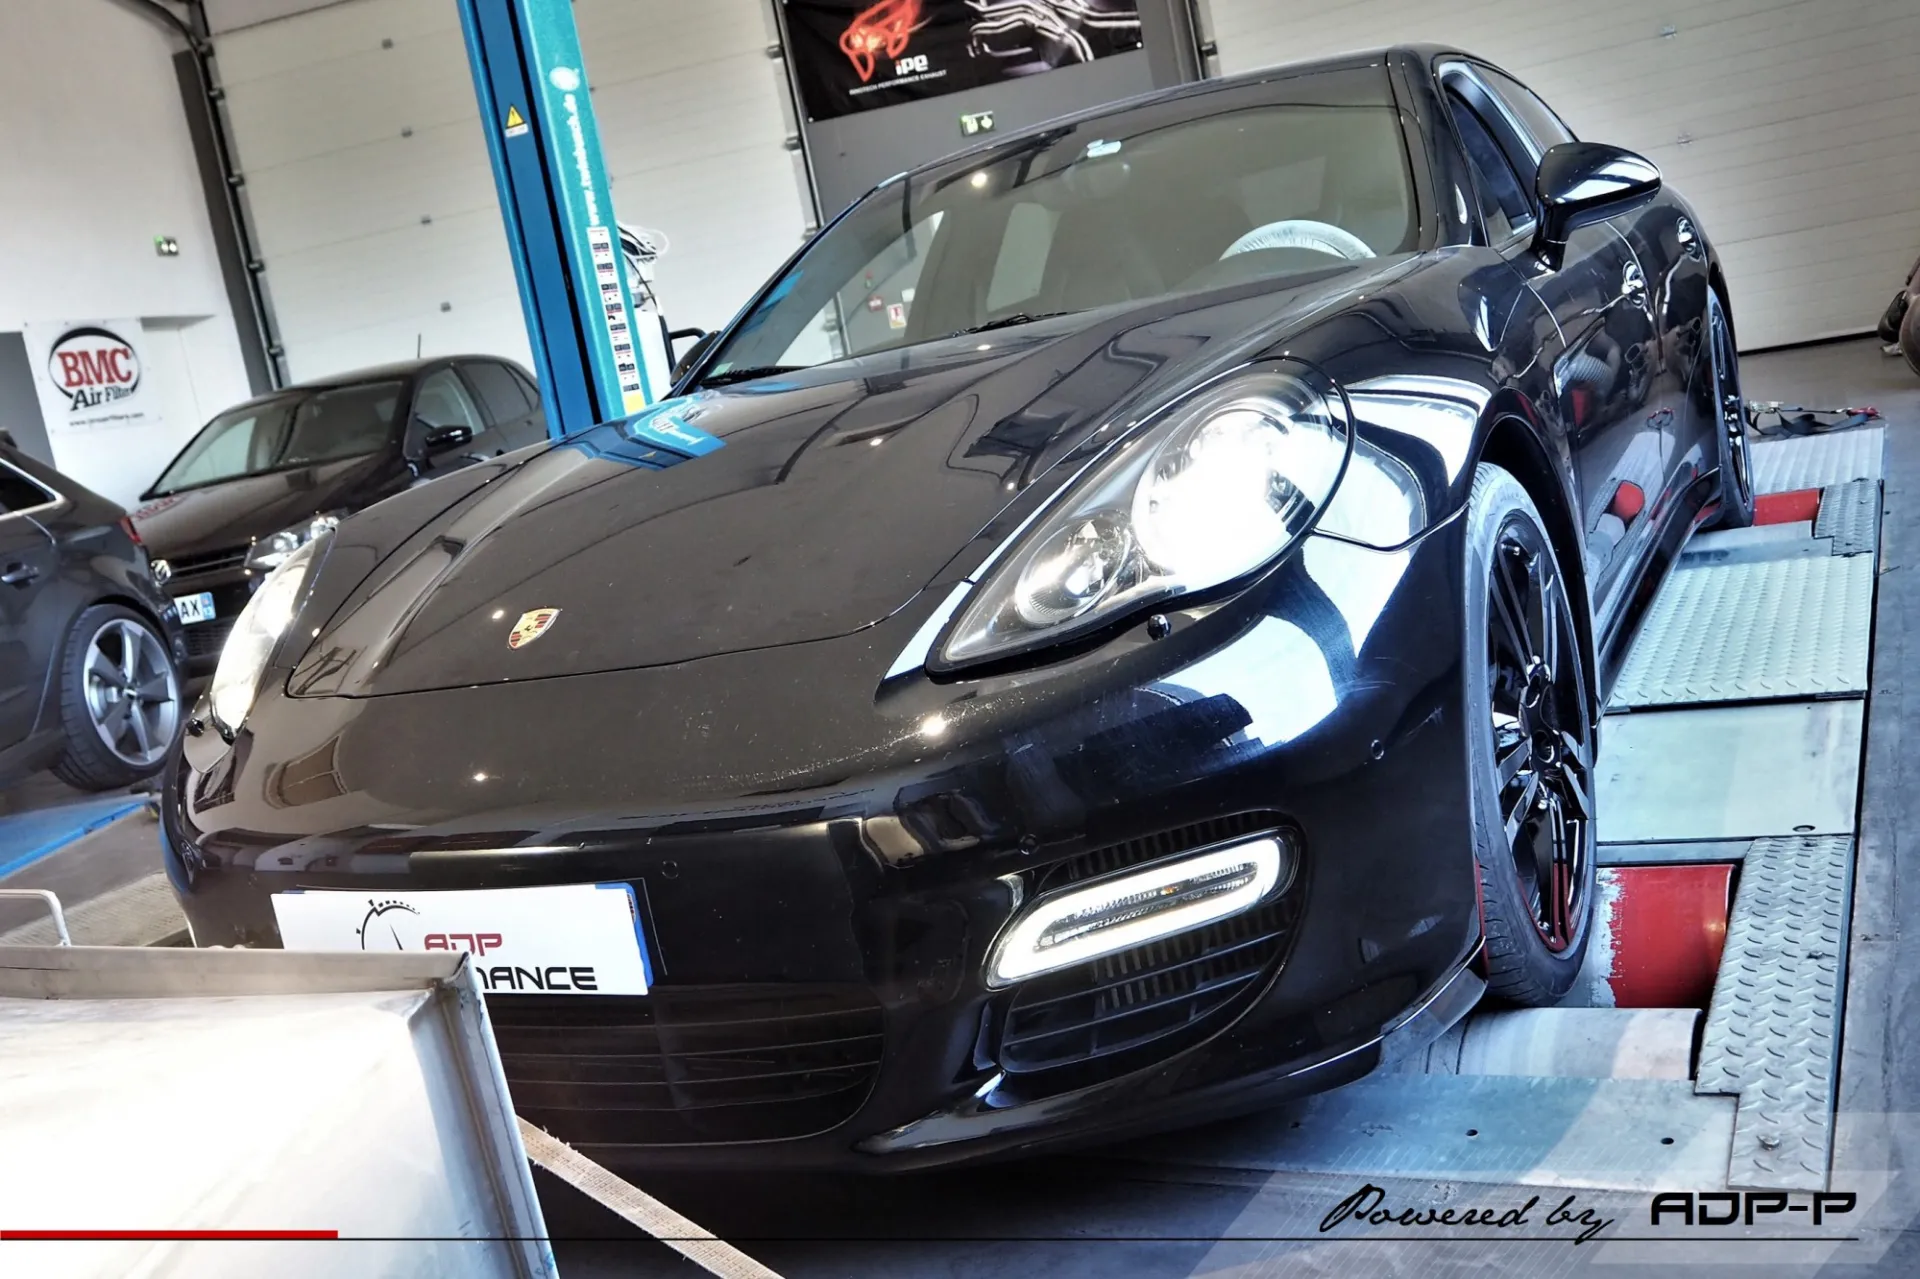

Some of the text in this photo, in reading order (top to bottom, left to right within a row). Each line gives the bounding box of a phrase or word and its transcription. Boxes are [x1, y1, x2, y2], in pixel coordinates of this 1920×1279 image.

[58, 348, 132, 387] BMC
[70, 386, 103, 411] Air
[181, 599, 201, 618] AX
[424, 933, 502, 956] ADP
